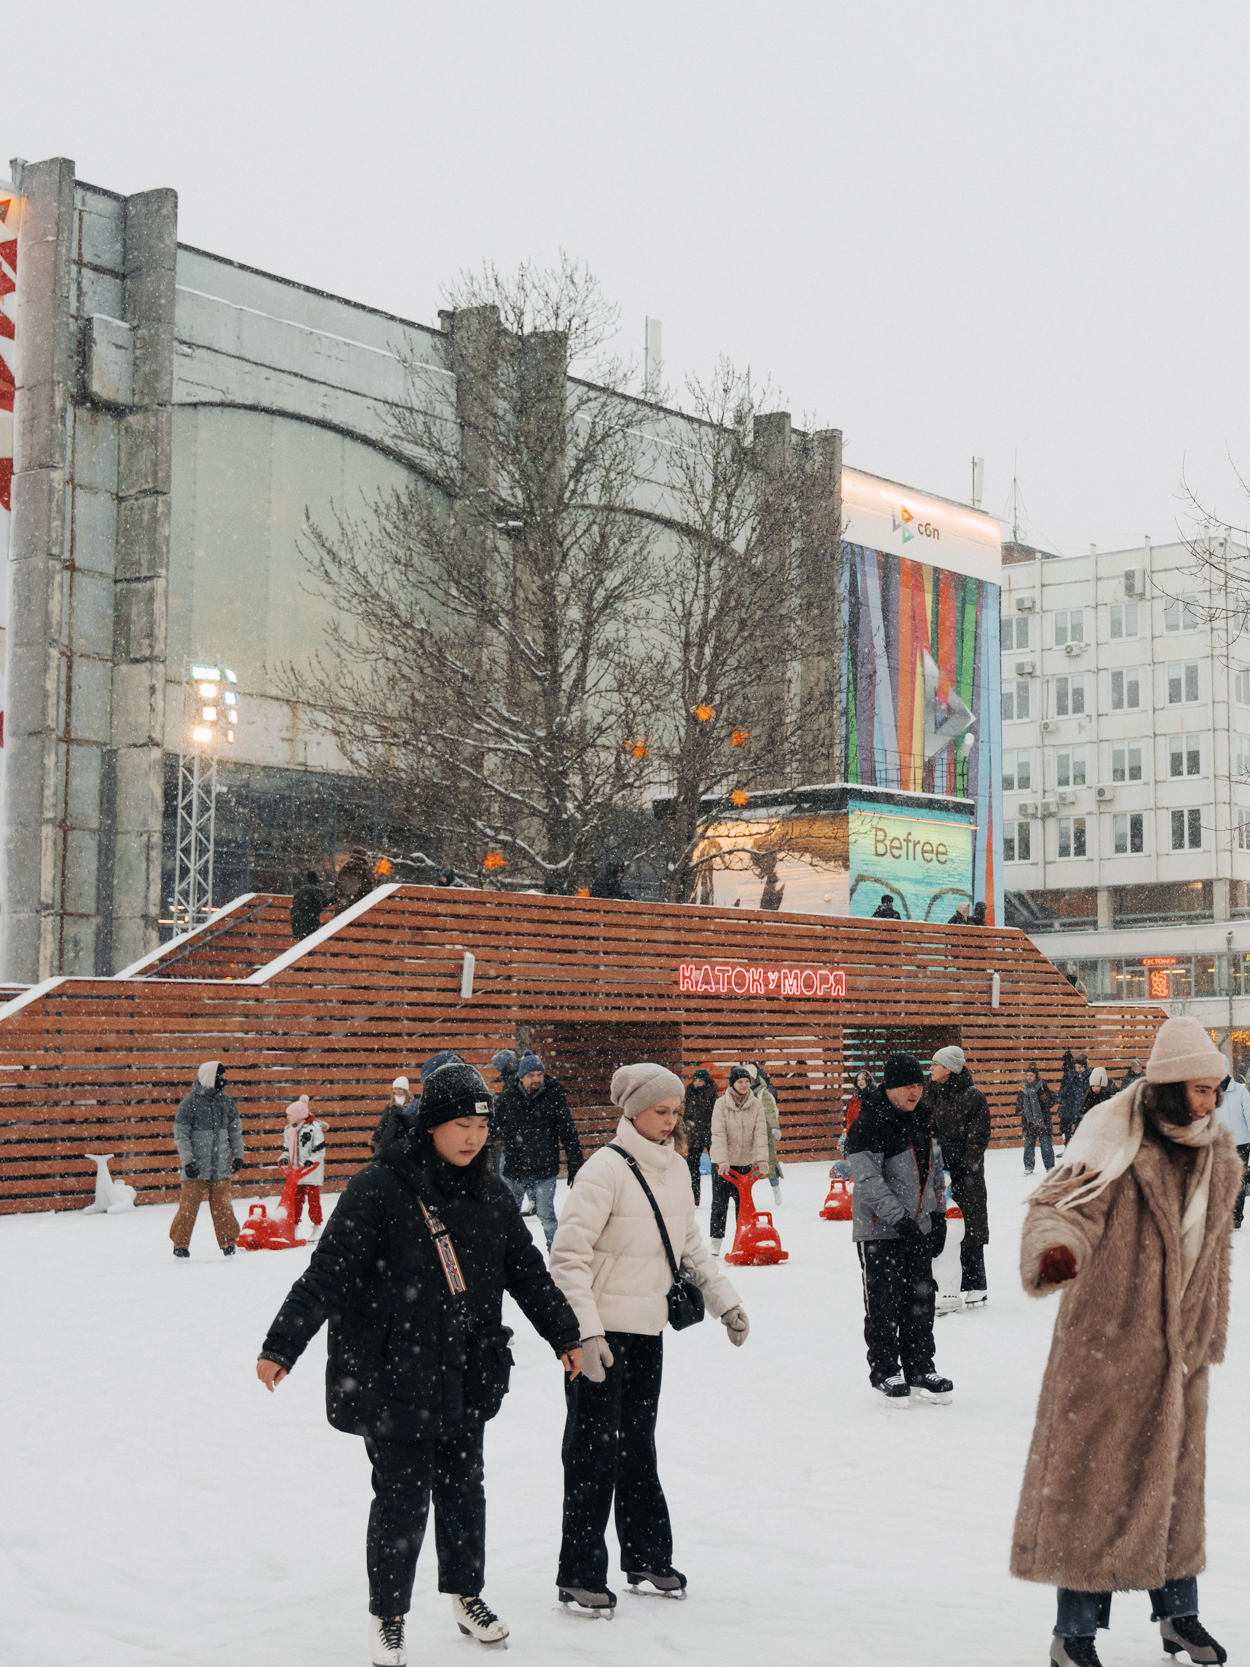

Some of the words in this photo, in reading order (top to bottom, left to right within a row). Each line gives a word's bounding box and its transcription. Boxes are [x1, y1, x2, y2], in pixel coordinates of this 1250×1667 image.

[917, 522, 940, 540] сбп
[874, 826, 949, 865] Befree
[679, 963, 765, 995] КАТОК
[780, 969, 847, 996] МОРЯ
